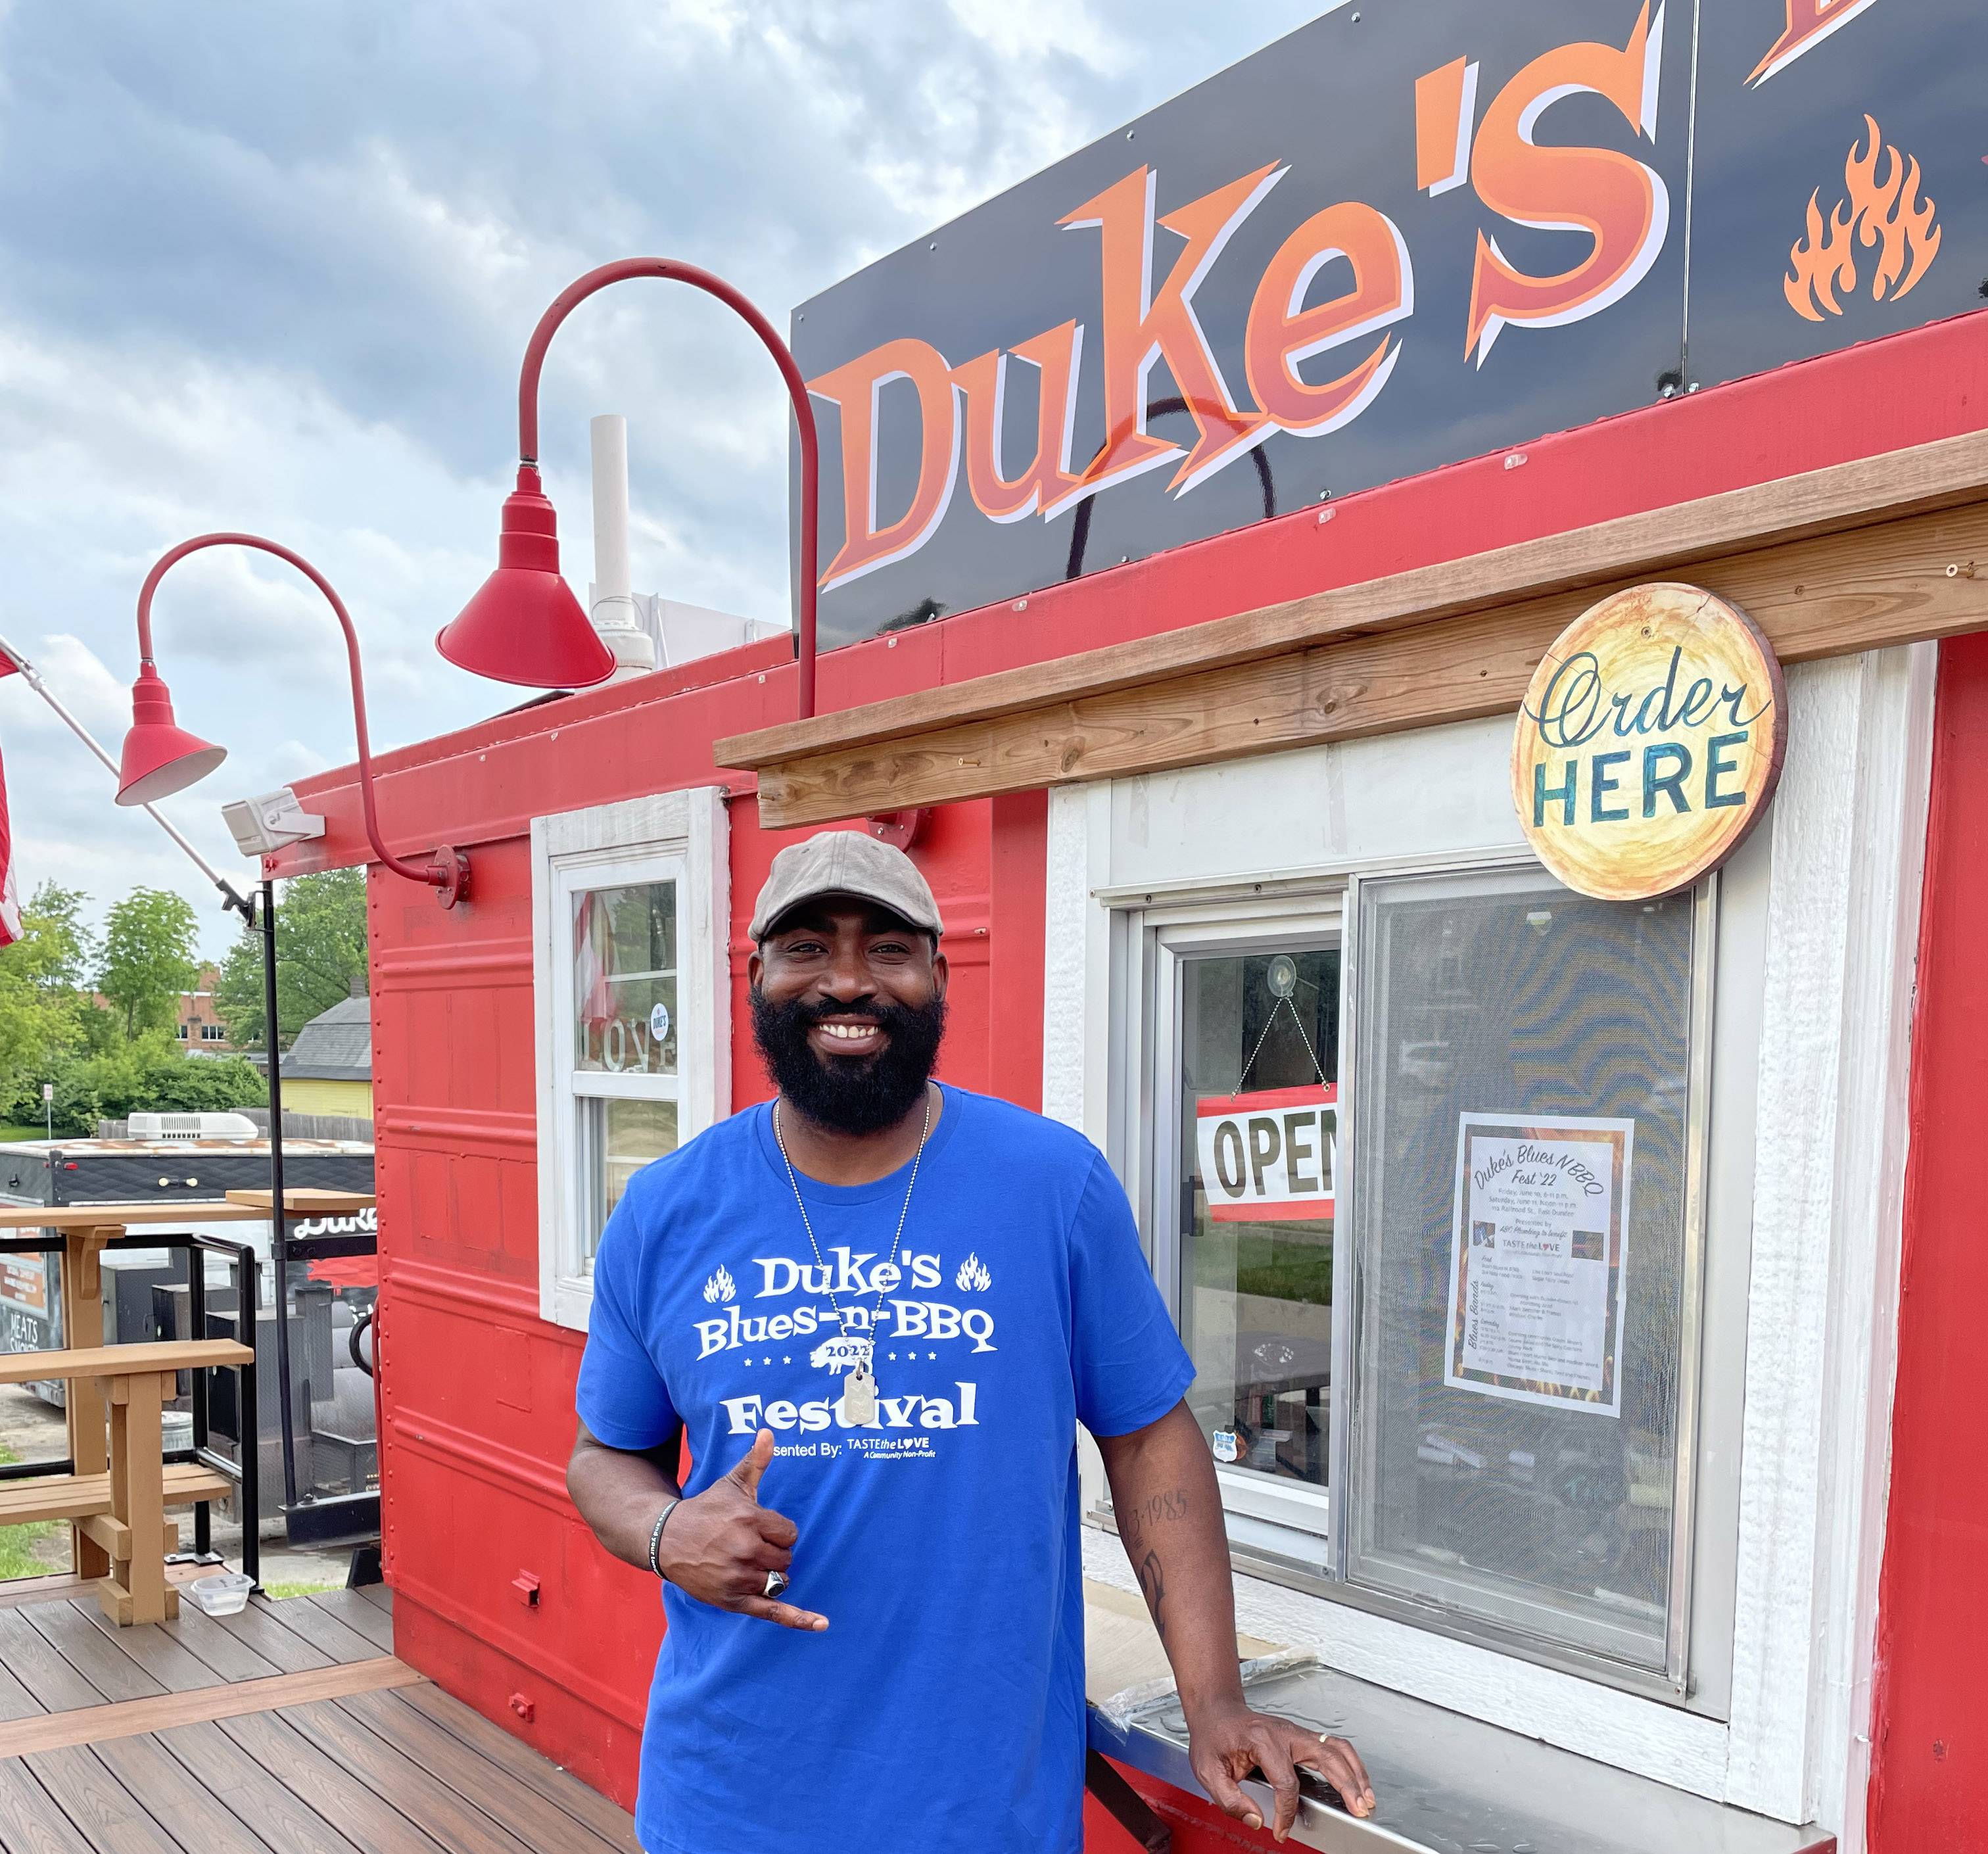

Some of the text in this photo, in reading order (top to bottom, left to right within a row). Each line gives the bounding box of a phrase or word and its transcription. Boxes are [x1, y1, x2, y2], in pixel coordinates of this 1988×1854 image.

[805, 0, 1670, 594] Duke's
[1523, 646, 1772, 748] Order
[1533, 730, 1749, 828] HERE
[1475, 1145, 1604, 1197] Duke's Blues N BBQ
[1511, 1169, 1536, 1185] Fest
[1503, 1239, 1525, 1248] TASTE
[1538, 1242, 1560, 1252] LVE
[751, 1246, 942, 1300] Duke's
[11, 1313, 38, 1344] MEATS
[692, 1298, 999, 1362] Blues-n-BBQ
[1467, 1279, 1479, 1350] Blues Bands
[826, 1345, 870, 1358] 2022
[772, 1442, 842, 1458] sented By:
[897, 1437, 930, 1448] LVE
